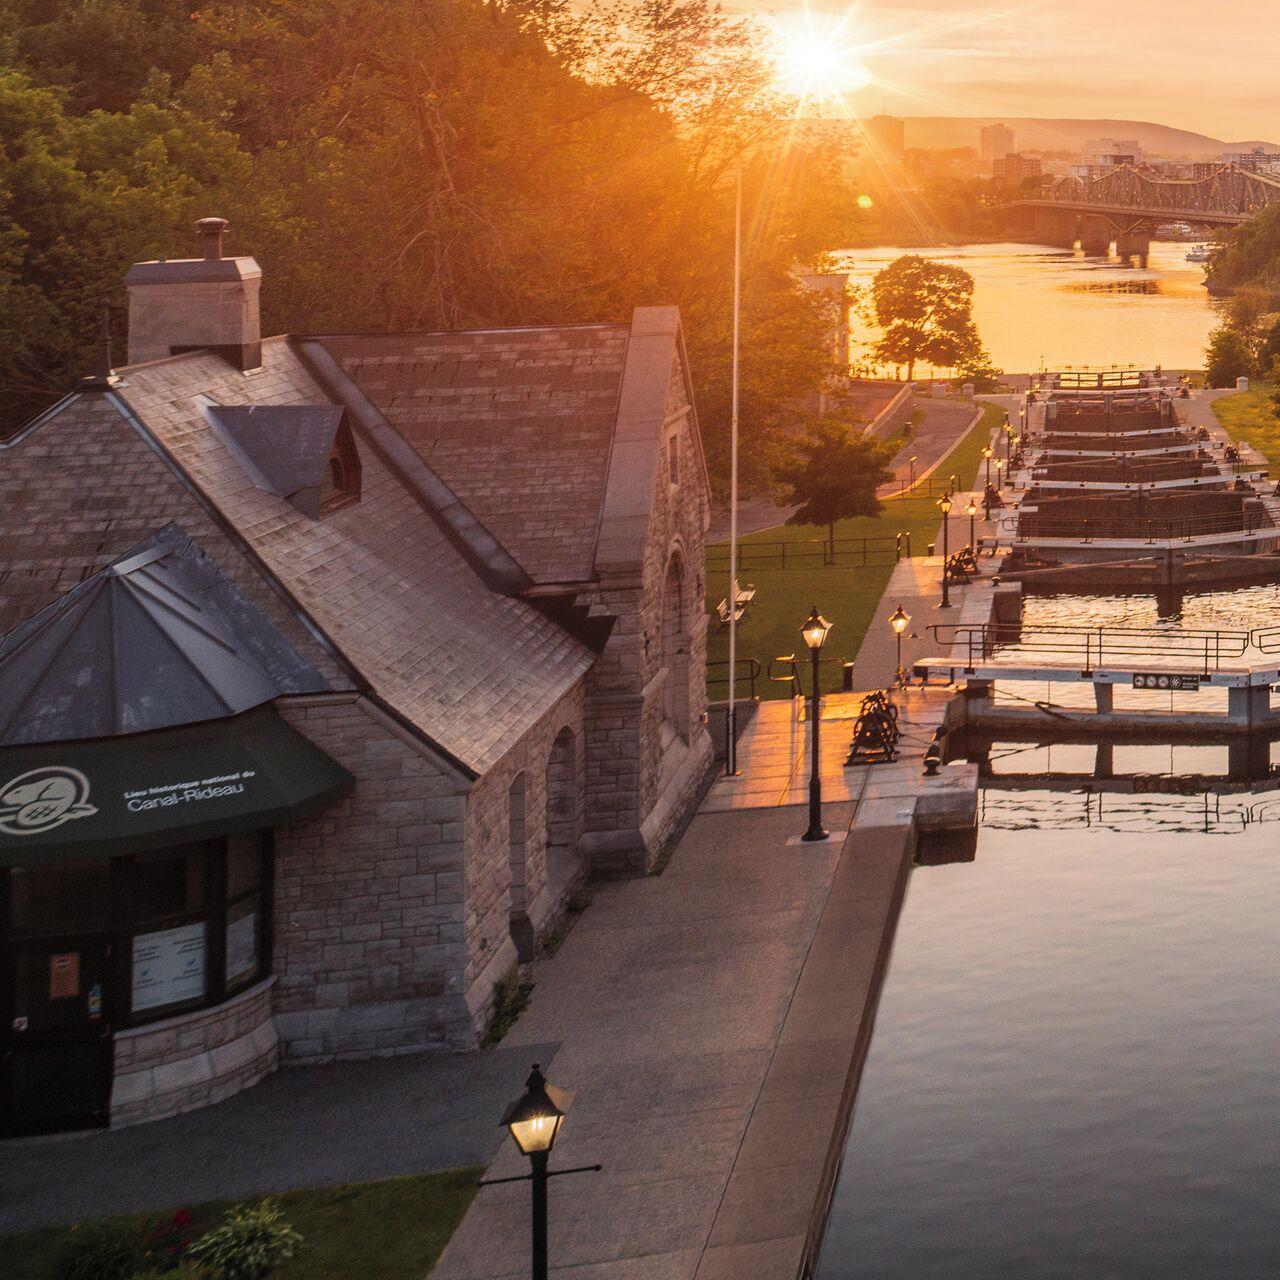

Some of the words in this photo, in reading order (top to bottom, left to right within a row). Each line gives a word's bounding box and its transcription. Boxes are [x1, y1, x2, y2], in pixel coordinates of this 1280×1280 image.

[149, 780, 200, 795] historique
[201, 772, 240, 785] national
[127, 783, 245, 812] Canal-Rideau
